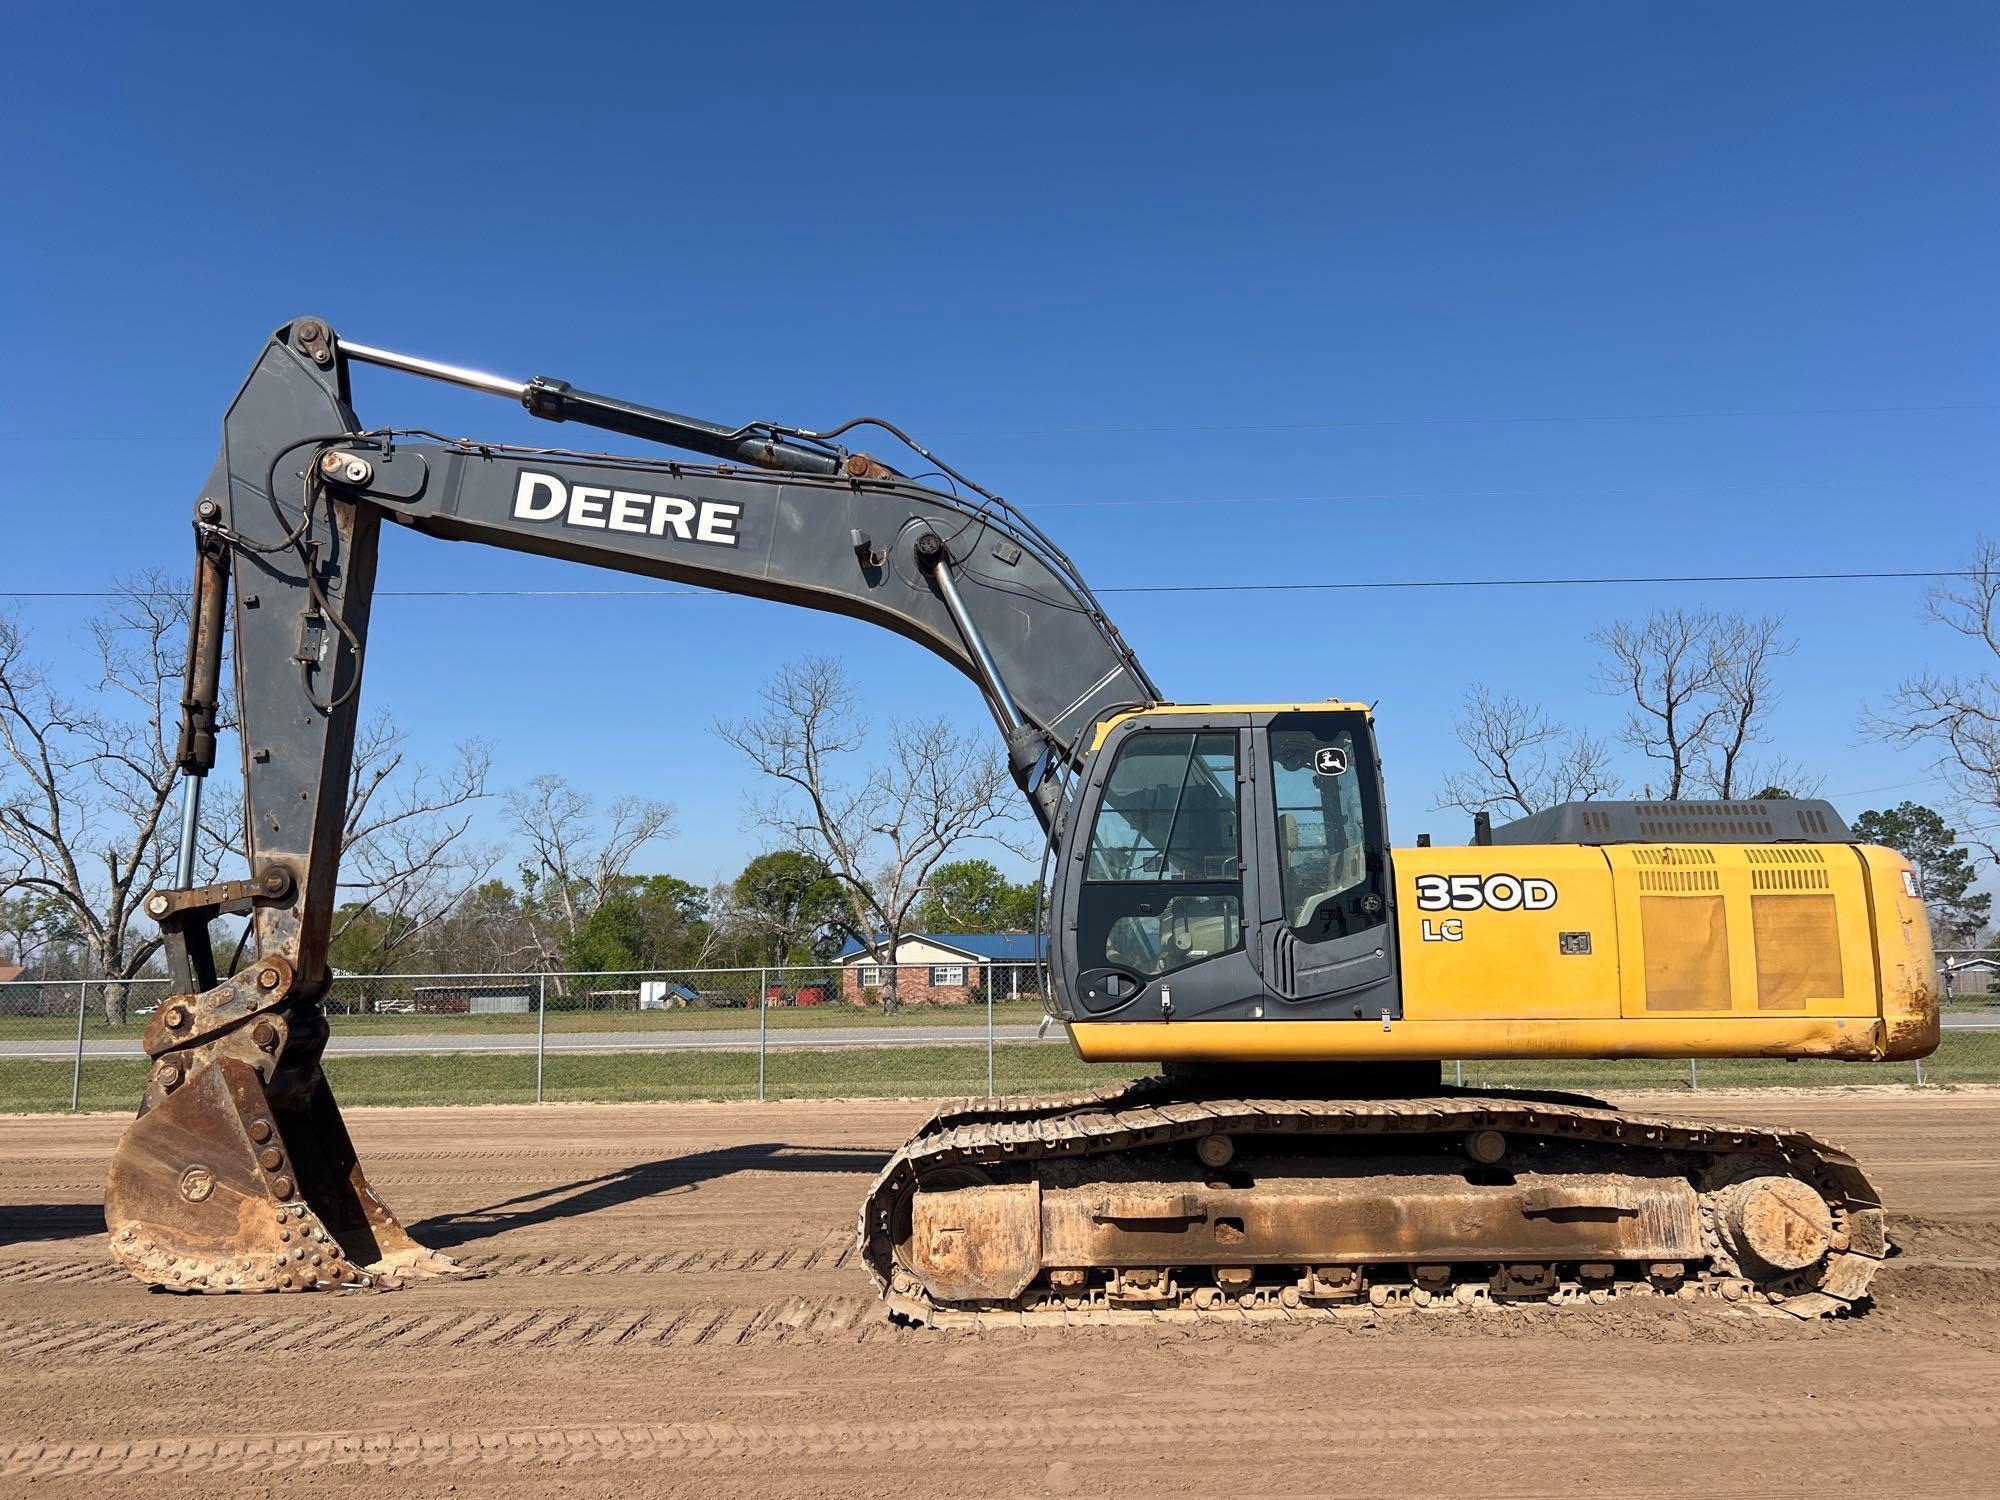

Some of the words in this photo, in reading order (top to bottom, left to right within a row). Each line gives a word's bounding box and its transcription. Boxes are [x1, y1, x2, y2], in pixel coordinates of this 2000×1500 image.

[512, 469, 742, 546] DEERE
[1416, 875, 1557, 911] 350D
[1422, 919, 1463, 941] LC
